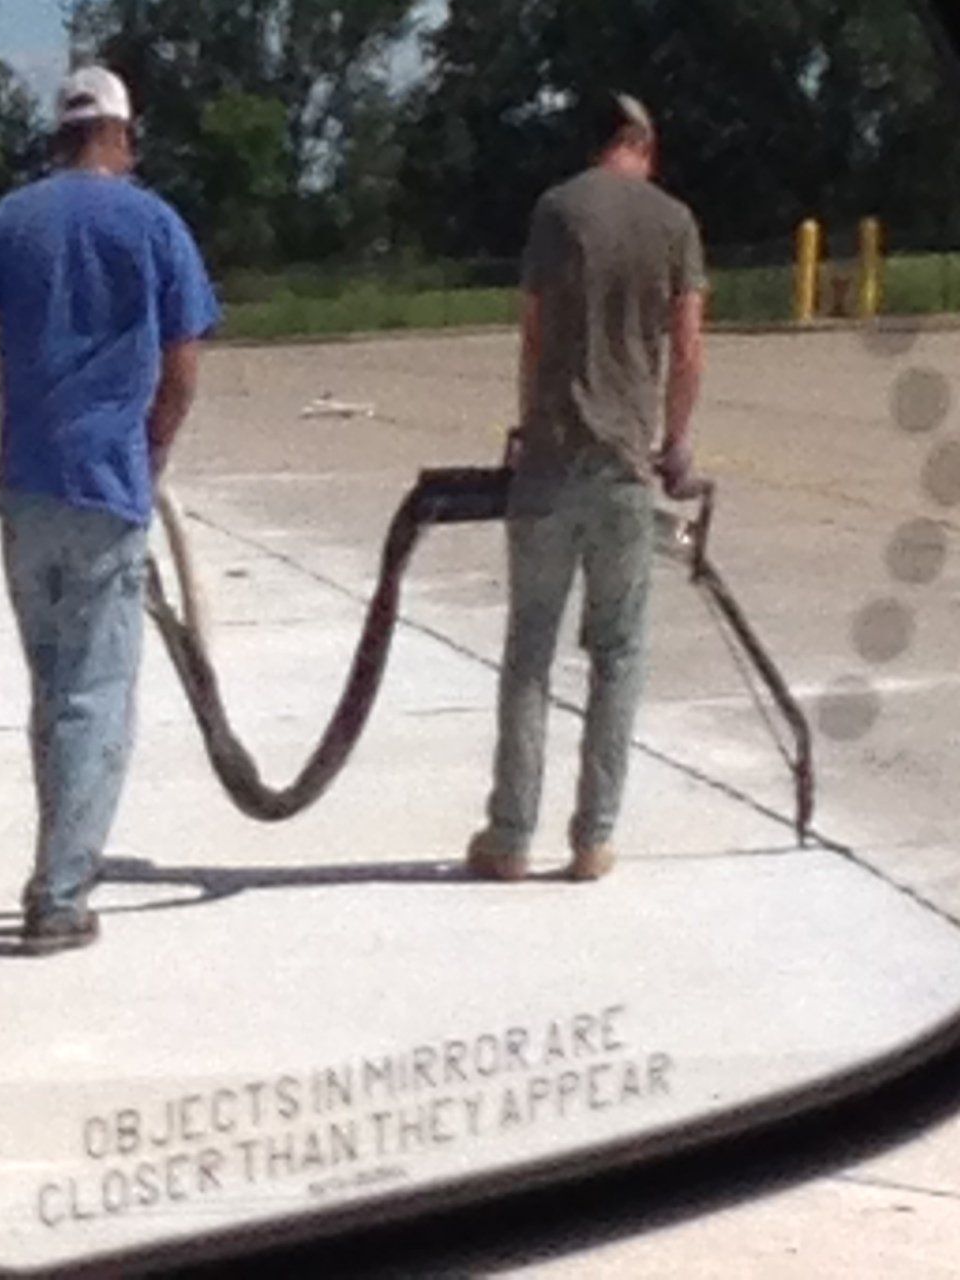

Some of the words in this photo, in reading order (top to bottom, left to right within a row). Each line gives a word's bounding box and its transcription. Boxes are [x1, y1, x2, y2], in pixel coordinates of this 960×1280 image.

[37, 1146, 224, 1228] CLOSER
[234, 1120, 359, 1185] THAN
[370, 1090, 483, 1156] THEY
[498, 1051, 675, 1129] APPEAR
[83, 1075, 301, 1161] OBJECTS
[311, 1066, 353, 1116] IN
[361, 1025, 529, 1101] MIRROR
[542, 1004, 626, 1066] ARE
